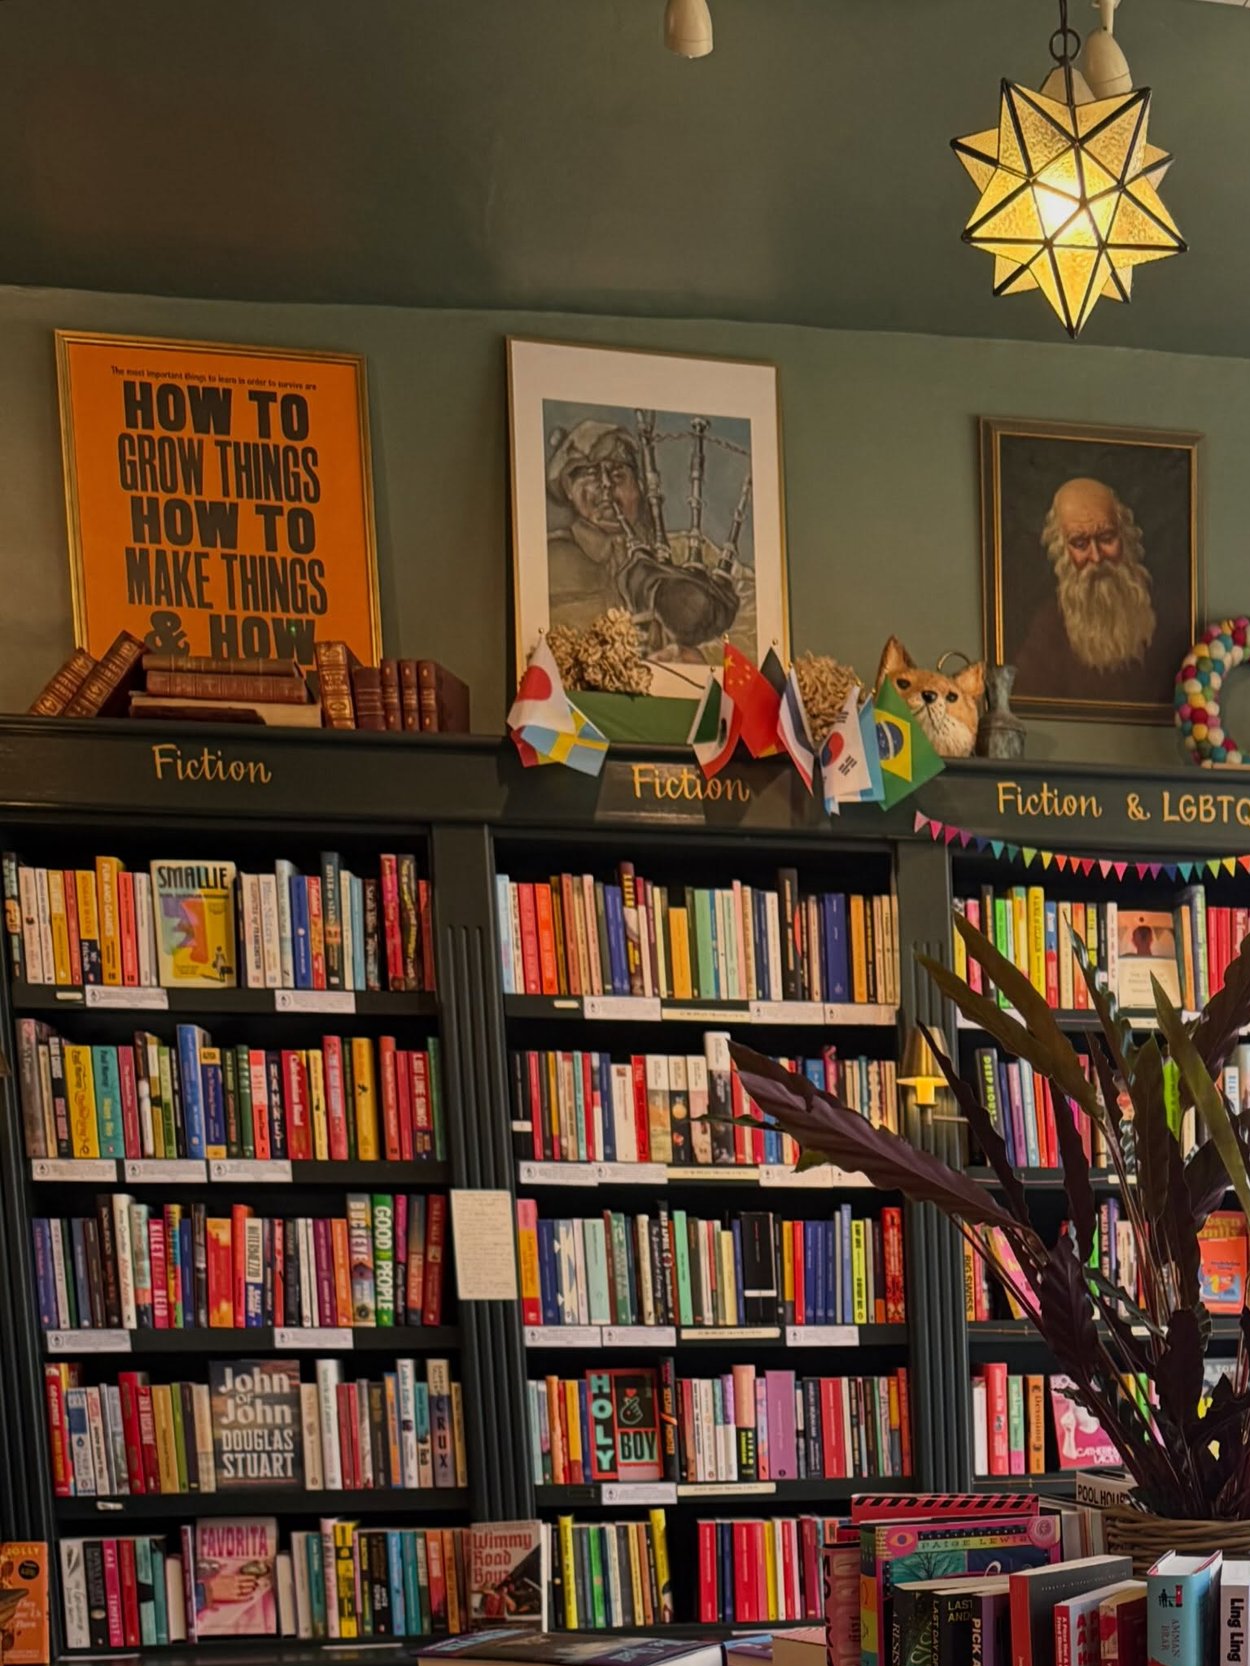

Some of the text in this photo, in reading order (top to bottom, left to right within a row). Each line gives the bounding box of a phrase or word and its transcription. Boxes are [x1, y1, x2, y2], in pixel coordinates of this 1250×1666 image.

[111, 365, 124, 376] The
[126, 369, 146, 378] most
[146, 371, 183, 382] important
[184, 373, 208, 384] things
[217, 375, 237, 385] learn
[247, 378, 267, 386] order
[278, 381, 303, 390] survive
[304, 383, 317, 391] are
[122, 380, 310, 442] HOW TO
[118, 432, 321, 504] GROW THINGS
[130, 495, 317, 555] HOW TO
[125, 546, 328, 616] MAKE THINGS
[144, 610, 316, 664] & HOW
[153, 744, 273, 785] Fiction
[630, 764, 751, 801] Fiction
[997, 781, 1103, 820] Fiction
[1127, 793, 1150, 821] &
[157, 865, 229, 889] SMALLIE
[100, 862, 114, 937] FUN AND GAMES
[350, 1201, 369, 1262] BUCKEYE
[150, 1224, 168, 1317] KILEY REID
[374, 1205, 394, 1311] GOOD PEOPLE
[219, 1366, 291, 1394] John
[220, 1398, 292, 1425] John
[236, 1392, 254, 1404] of
[435, 1398, 449, 1471] CRUX
[589, 1373, 615, 1471] HOLY
[221, 1429, 294, 1451] DOUGLAS
[620, 1430, 656, 1461] BOY
[222, 1453, 295, 1479] STUART
[1077, 1482, 1098, 1502] POOL
[200, 1525, 269, 1558] FAVORITA
[473, 1532, 533, 1550] Wimmy
[920, 1534, 1028, 1550] PAIGE LEWIS
[473, 1550, 512, 1567] Road
[106, 1548, 121, 1637] KAE TEMPEST
[932, 1600, 940, 1628] LAST
[1227, 1598, 1244, 1628] Ling
[932, 1629, 940, 1649] DAY
[972, 1617, 982, 1654] PICK
[1227, 1633, 1244, 1662] Ling
[932, 1652, 940, 1666] OF
